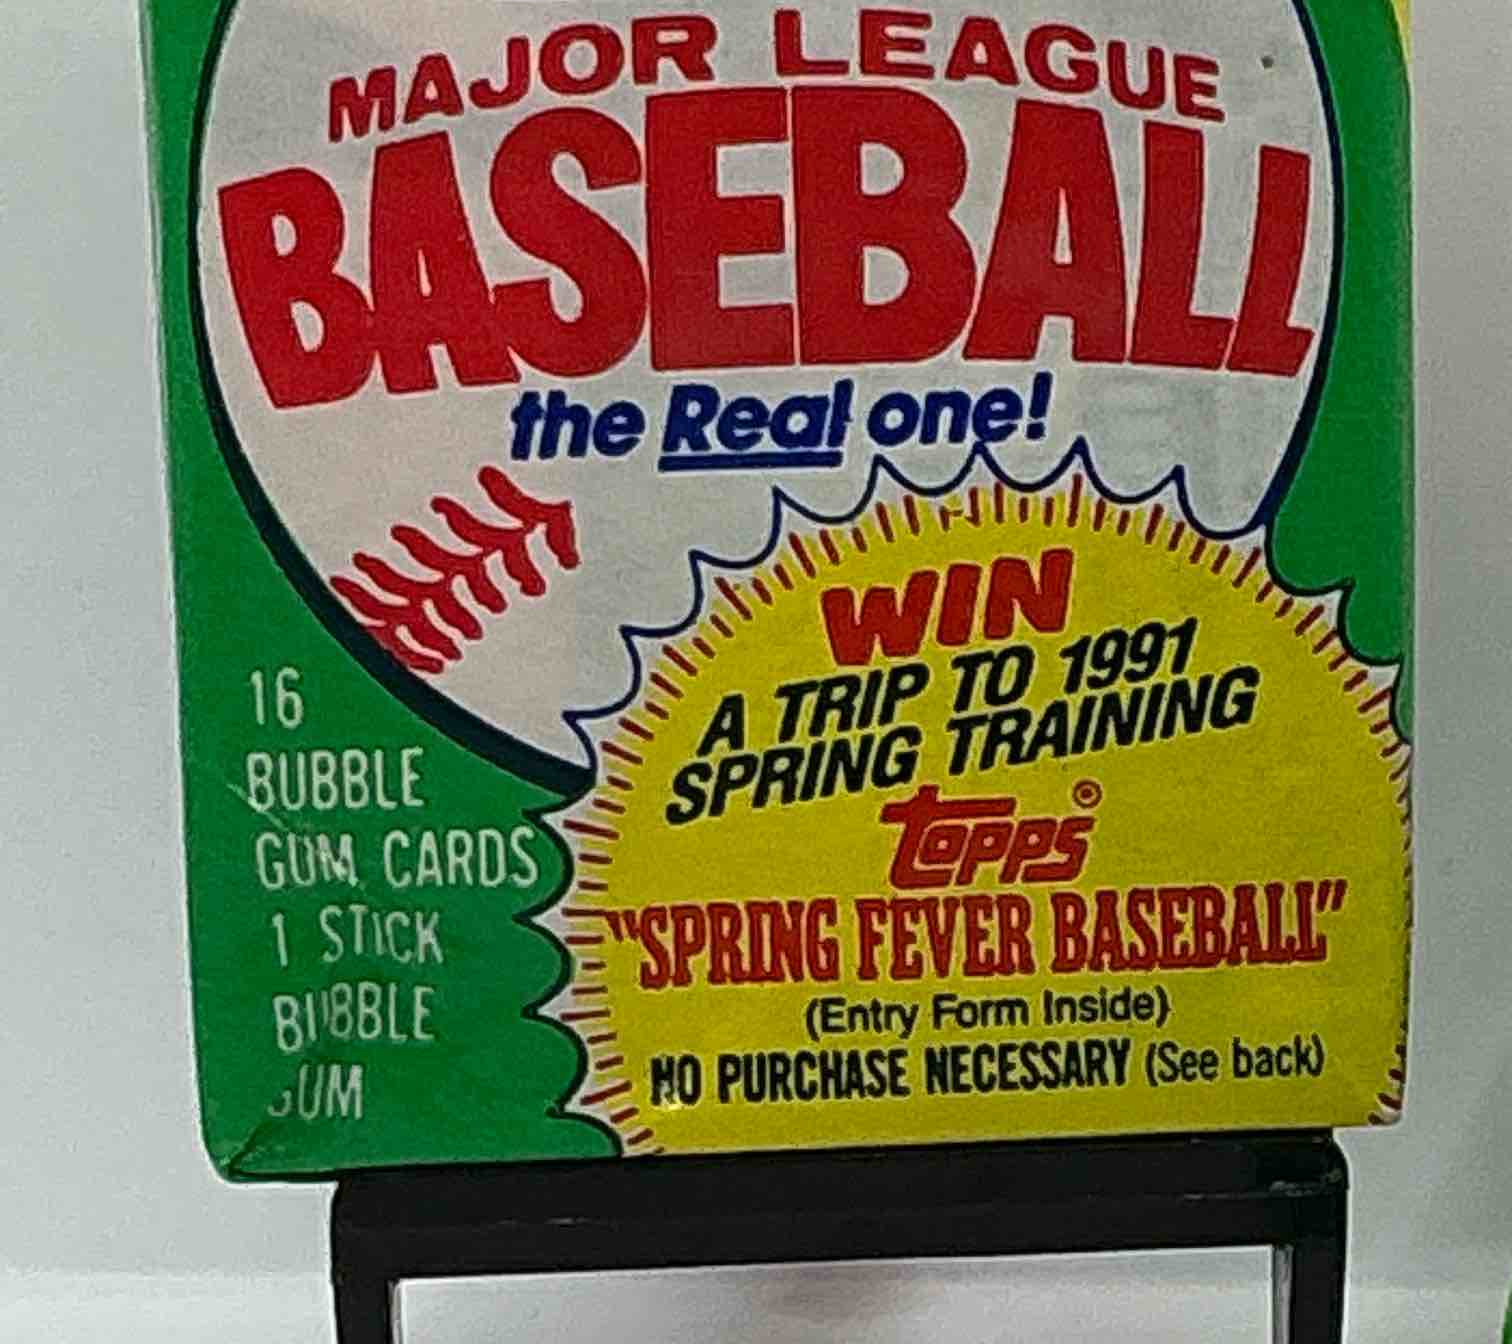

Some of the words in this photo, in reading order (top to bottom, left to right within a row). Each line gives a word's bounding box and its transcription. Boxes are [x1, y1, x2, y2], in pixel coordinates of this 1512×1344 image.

[329, 12, 718, 144] MAJOR
[774, 9, 1225, 124] LEAGUE
[218, 87, 1313, 410] BASEBALL
[510, 389, 645, 460] the
[660, 378, 854, 456] Real
[866, 371, 1051, 444] one!
[821, 548, 1074, 666] WIN
[250, 666, 303, 730] 16
[697, 694, 745, 757] A
[774, 664, 930, 745] TRIP
[951, 645, 1036, 712] TO
[1060, 617, 1198, 694] 1991
[246, 746, 424, 812] BUBBLE
[665, 726, 922, 827] SPRING
[947, 665, 1261, 778] TRAINING
[256, 832, 358, 890] GUM
[384, 825, 539, 889] CARDS
[271, 912, 288, 968] 1
[318, 904, 444, 964] STICK
[605, 898, 840, 990] "SPRING
[855, 893, 1035, 981] FEVER
[1050, 879, 1348, 973] BASEBALL"
[805, 996, 919, 1043] (Entry
[932, 993, 1029, 1030] Form
[1044, 984, 1171, 1028] Inside)
[650, 1055, 702, 1106] NO
[717, 1048, 911, 1104] PURCHASE
[924, 1038, 1131, 1095] NECESSARY
[1146, 1040, 1218, 1088] (See
[1232, 1031, 1325, 1078] back)
